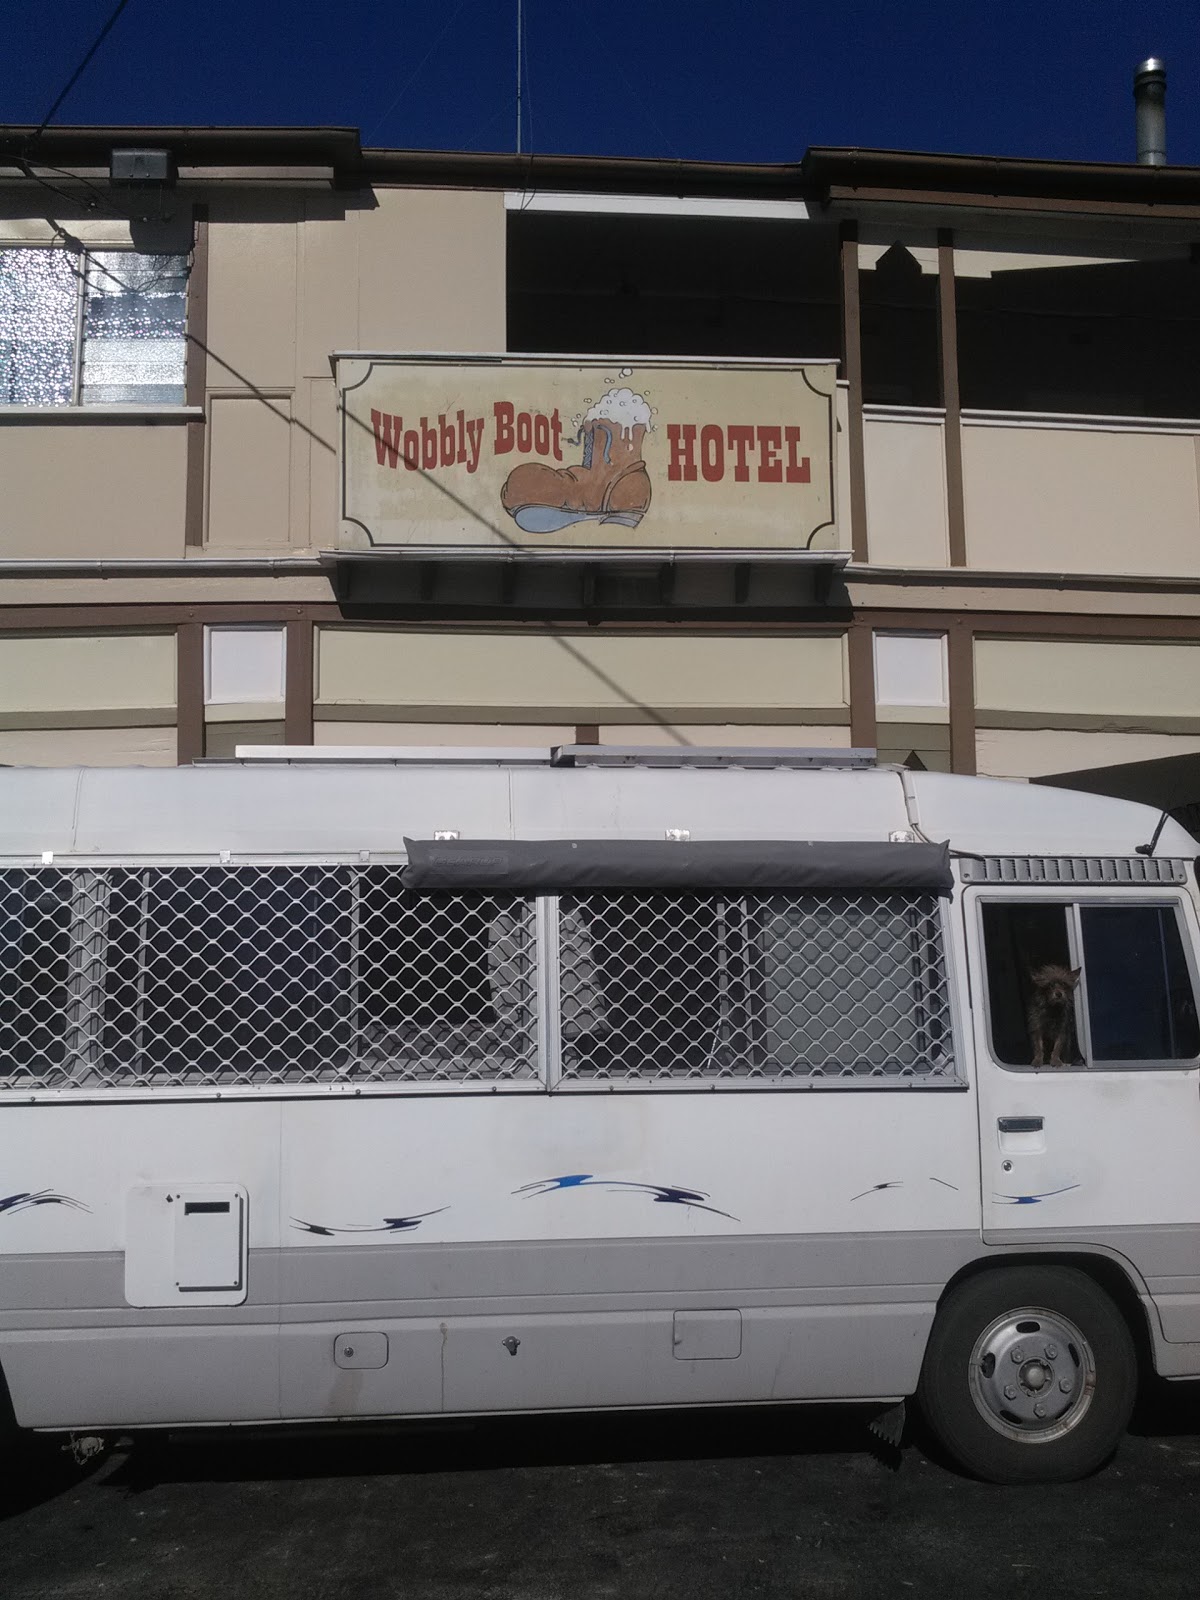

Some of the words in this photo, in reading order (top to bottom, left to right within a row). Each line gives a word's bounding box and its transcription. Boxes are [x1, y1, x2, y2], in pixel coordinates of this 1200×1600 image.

[371, 409, 484, 473] Wobbly
[494, 401, 563, 461] Boot
[668, 424, 811, 483] HOTEL
